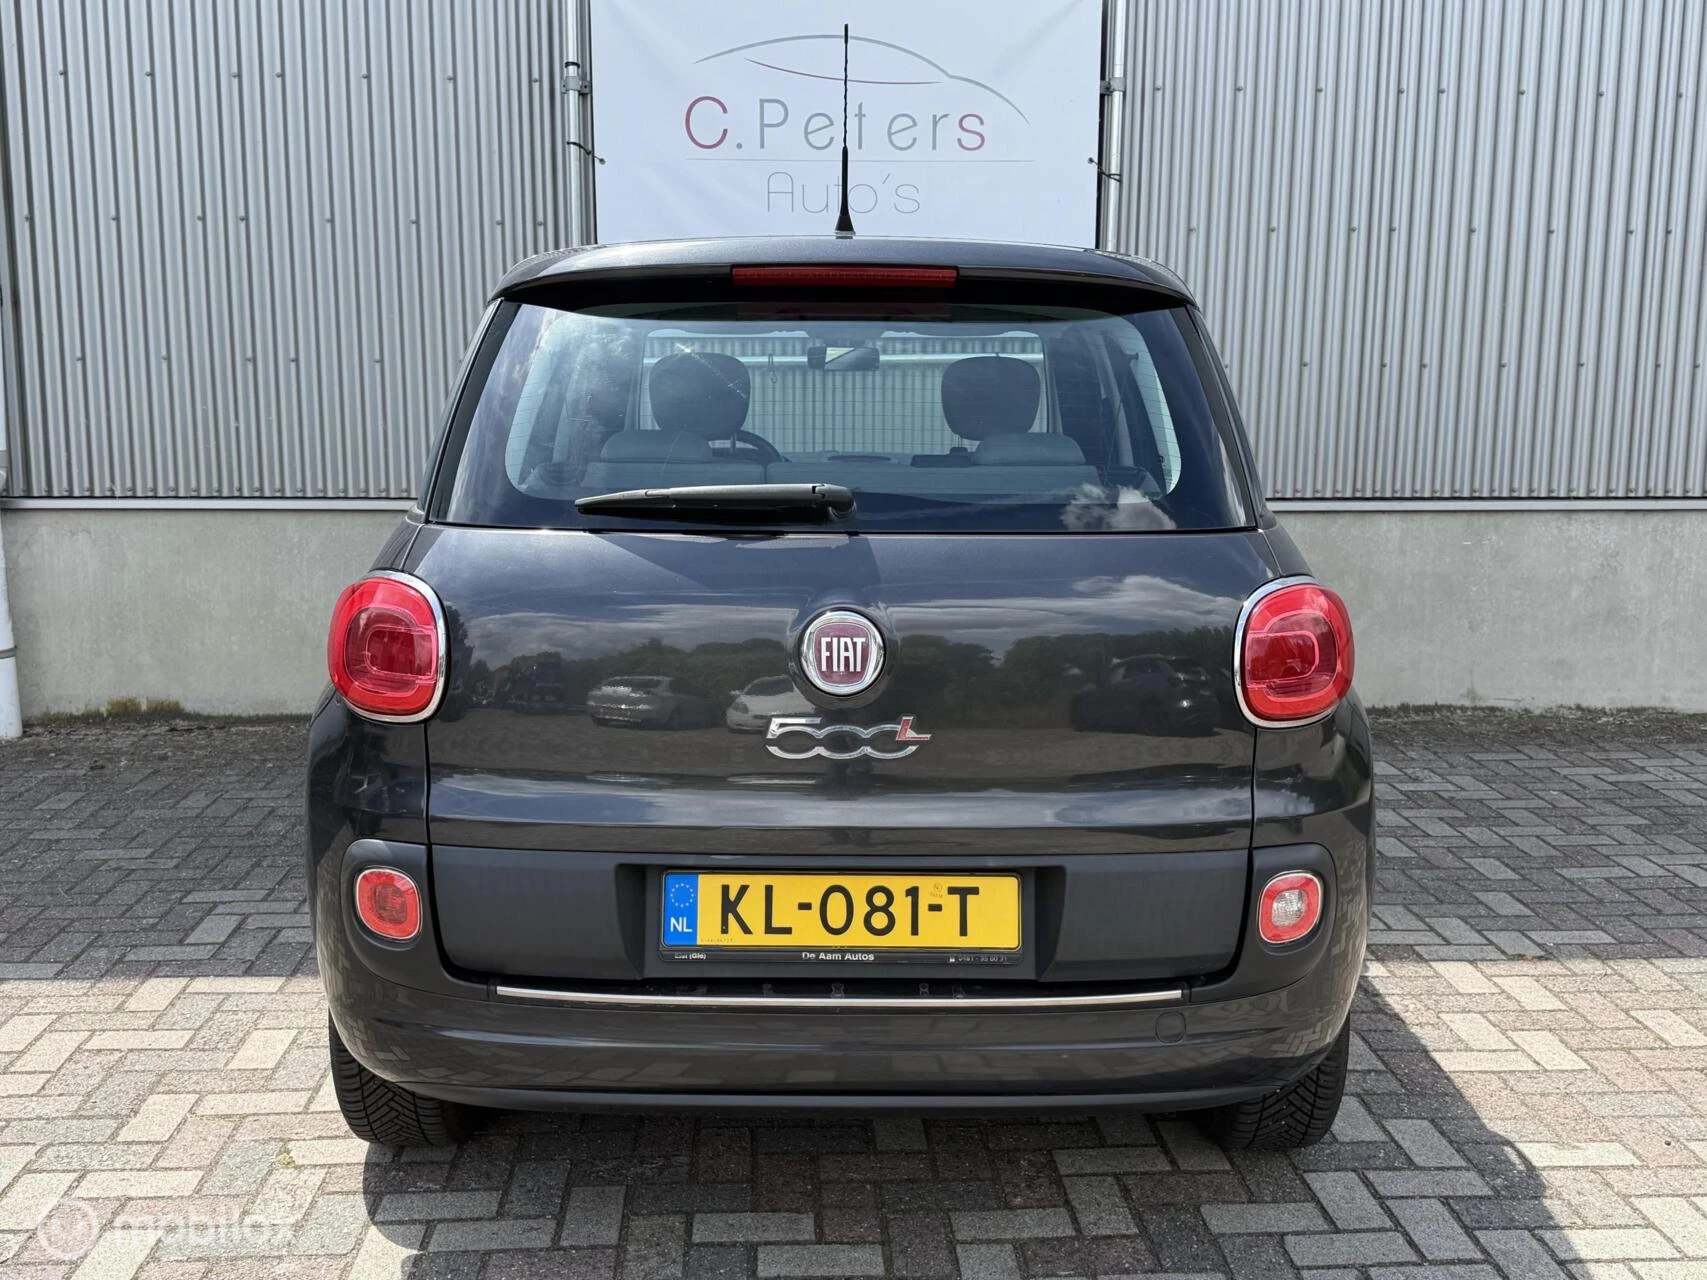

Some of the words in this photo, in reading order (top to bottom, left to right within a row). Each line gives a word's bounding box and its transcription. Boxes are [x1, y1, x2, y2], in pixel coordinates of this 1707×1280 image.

[820, 637, 866, 672] FIAT
[721, 884, 980, 936] KL-081-T
[670, 917, 692, 932] NL
[802, 952, 816, 960] De
[844, 953, 875, 961] Autos
